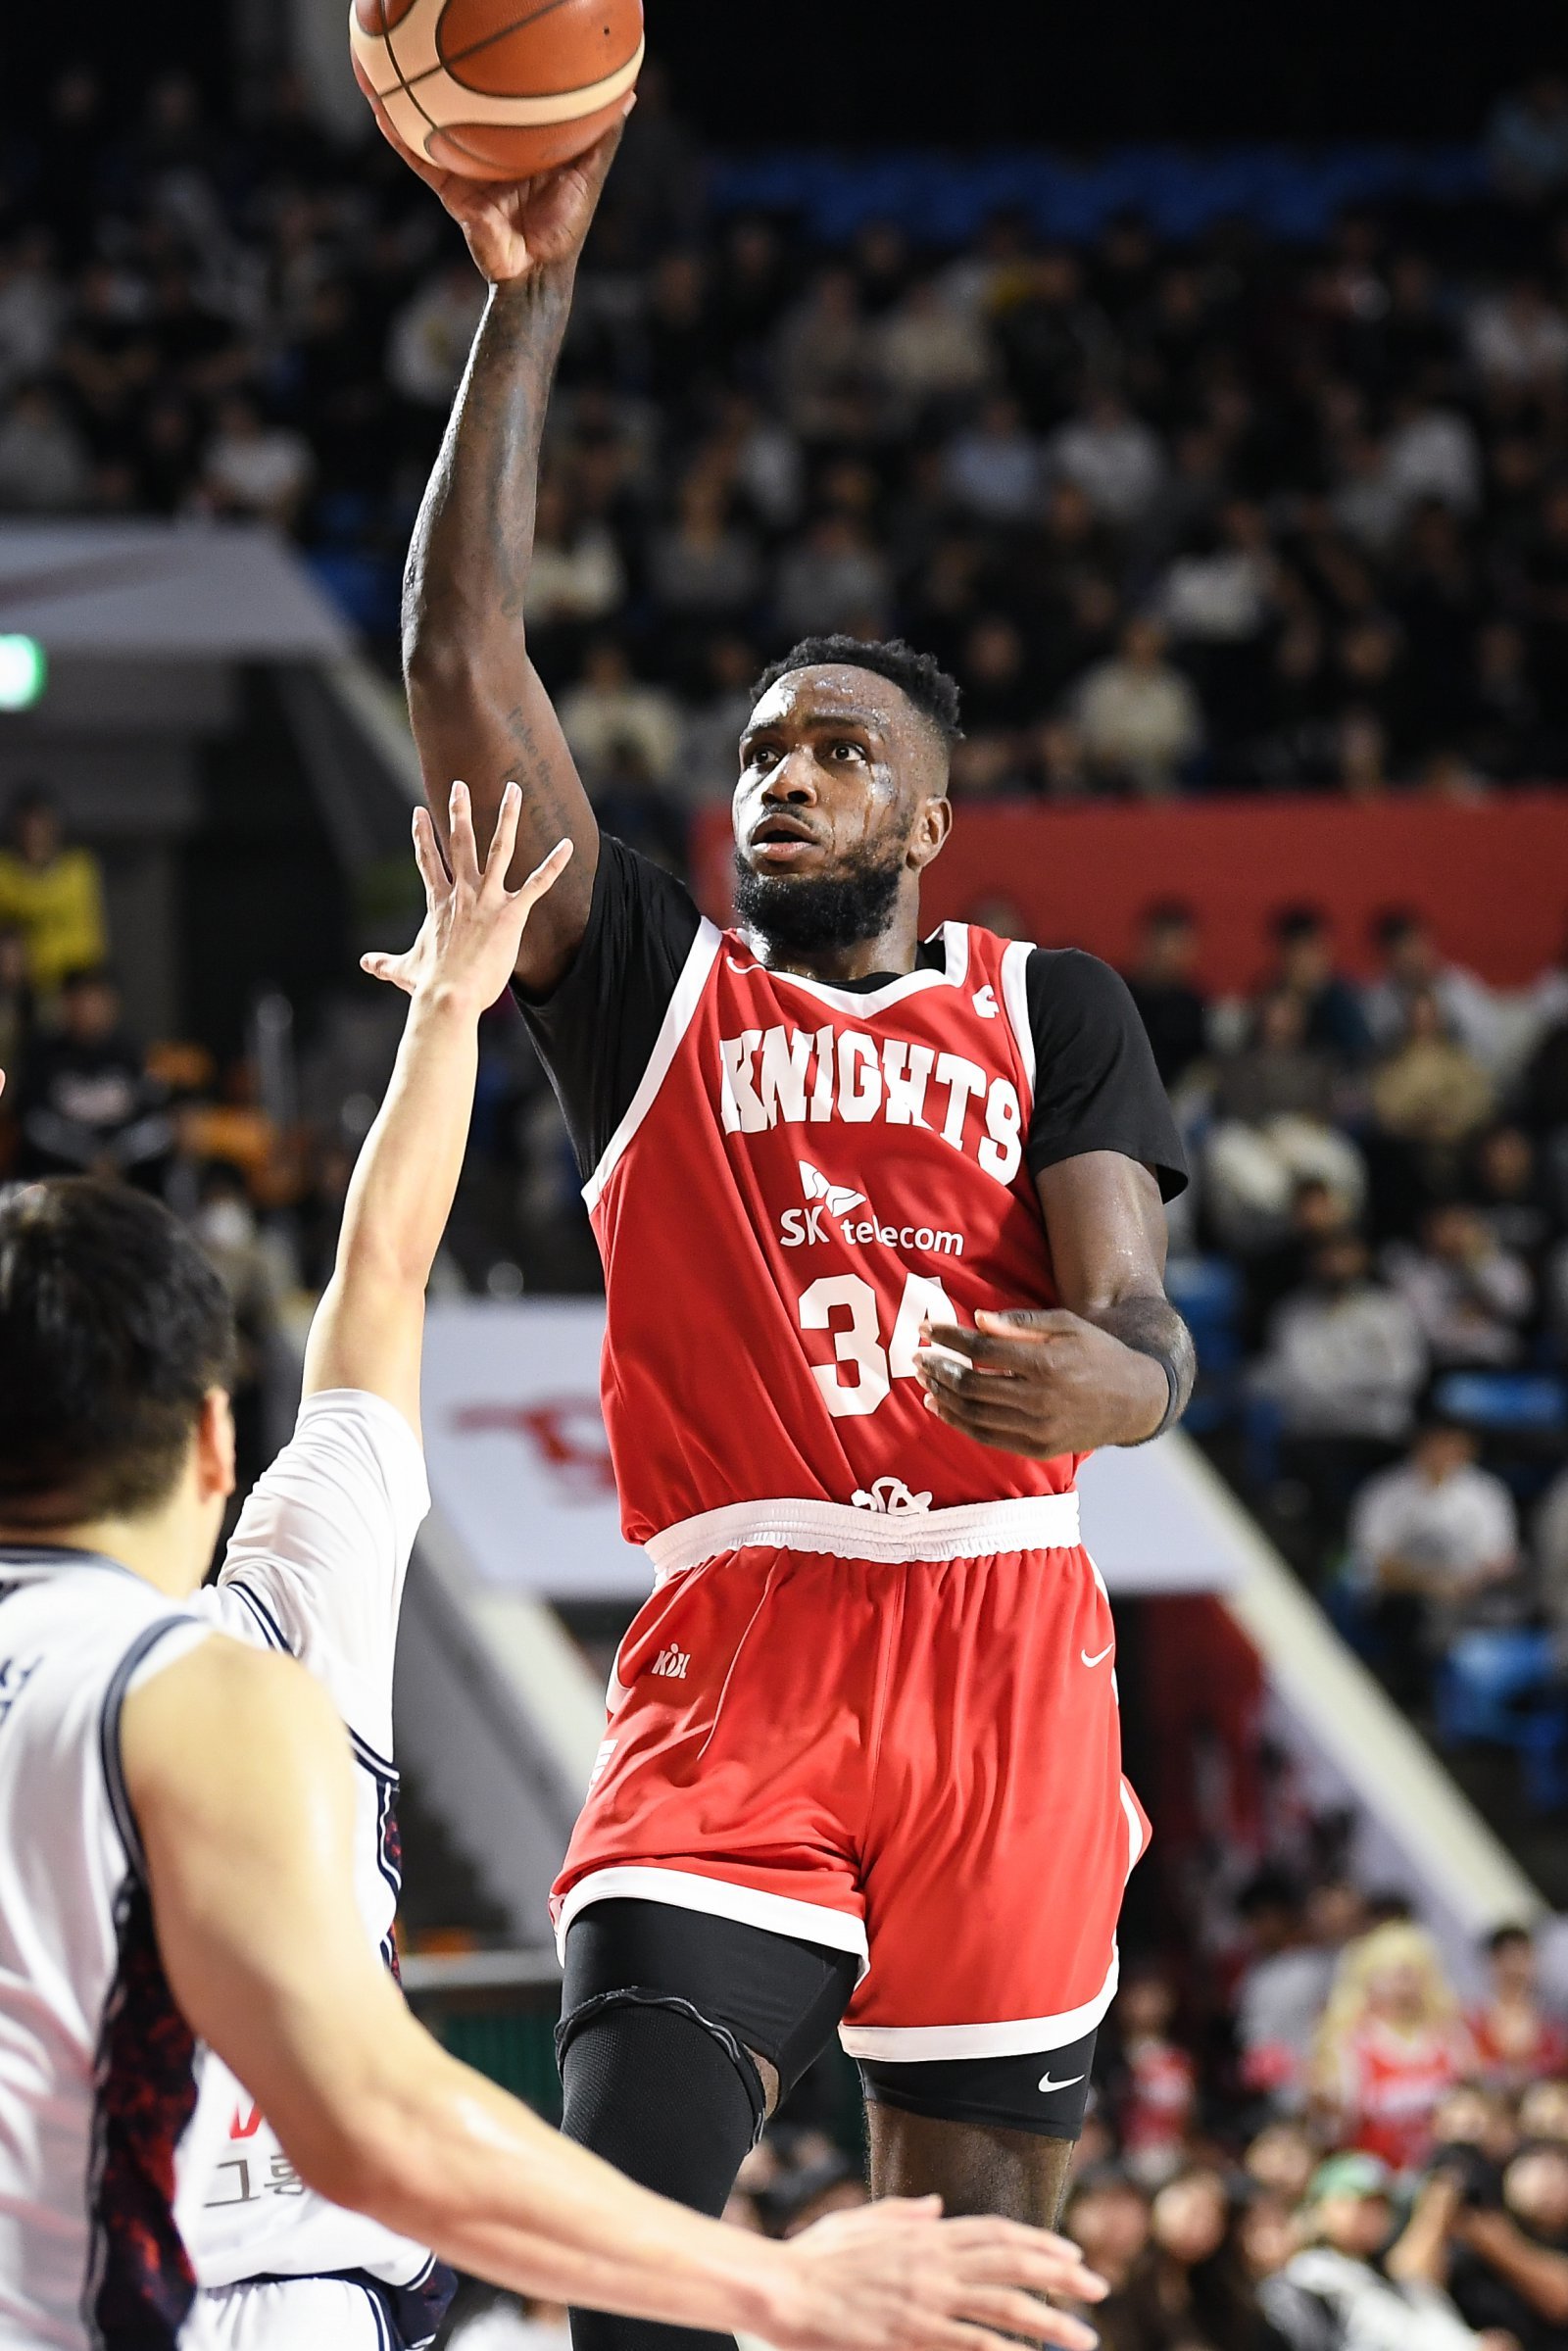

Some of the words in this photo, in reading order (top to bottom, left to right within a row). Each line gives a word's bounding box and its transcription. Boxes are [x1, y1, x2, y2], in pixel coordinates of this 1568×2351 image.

[718, 1024, 1023, 1188] KNIGHTS
[780, 1205, 830, 1248] SK
[841, 1215, 964, 1256] telecom
